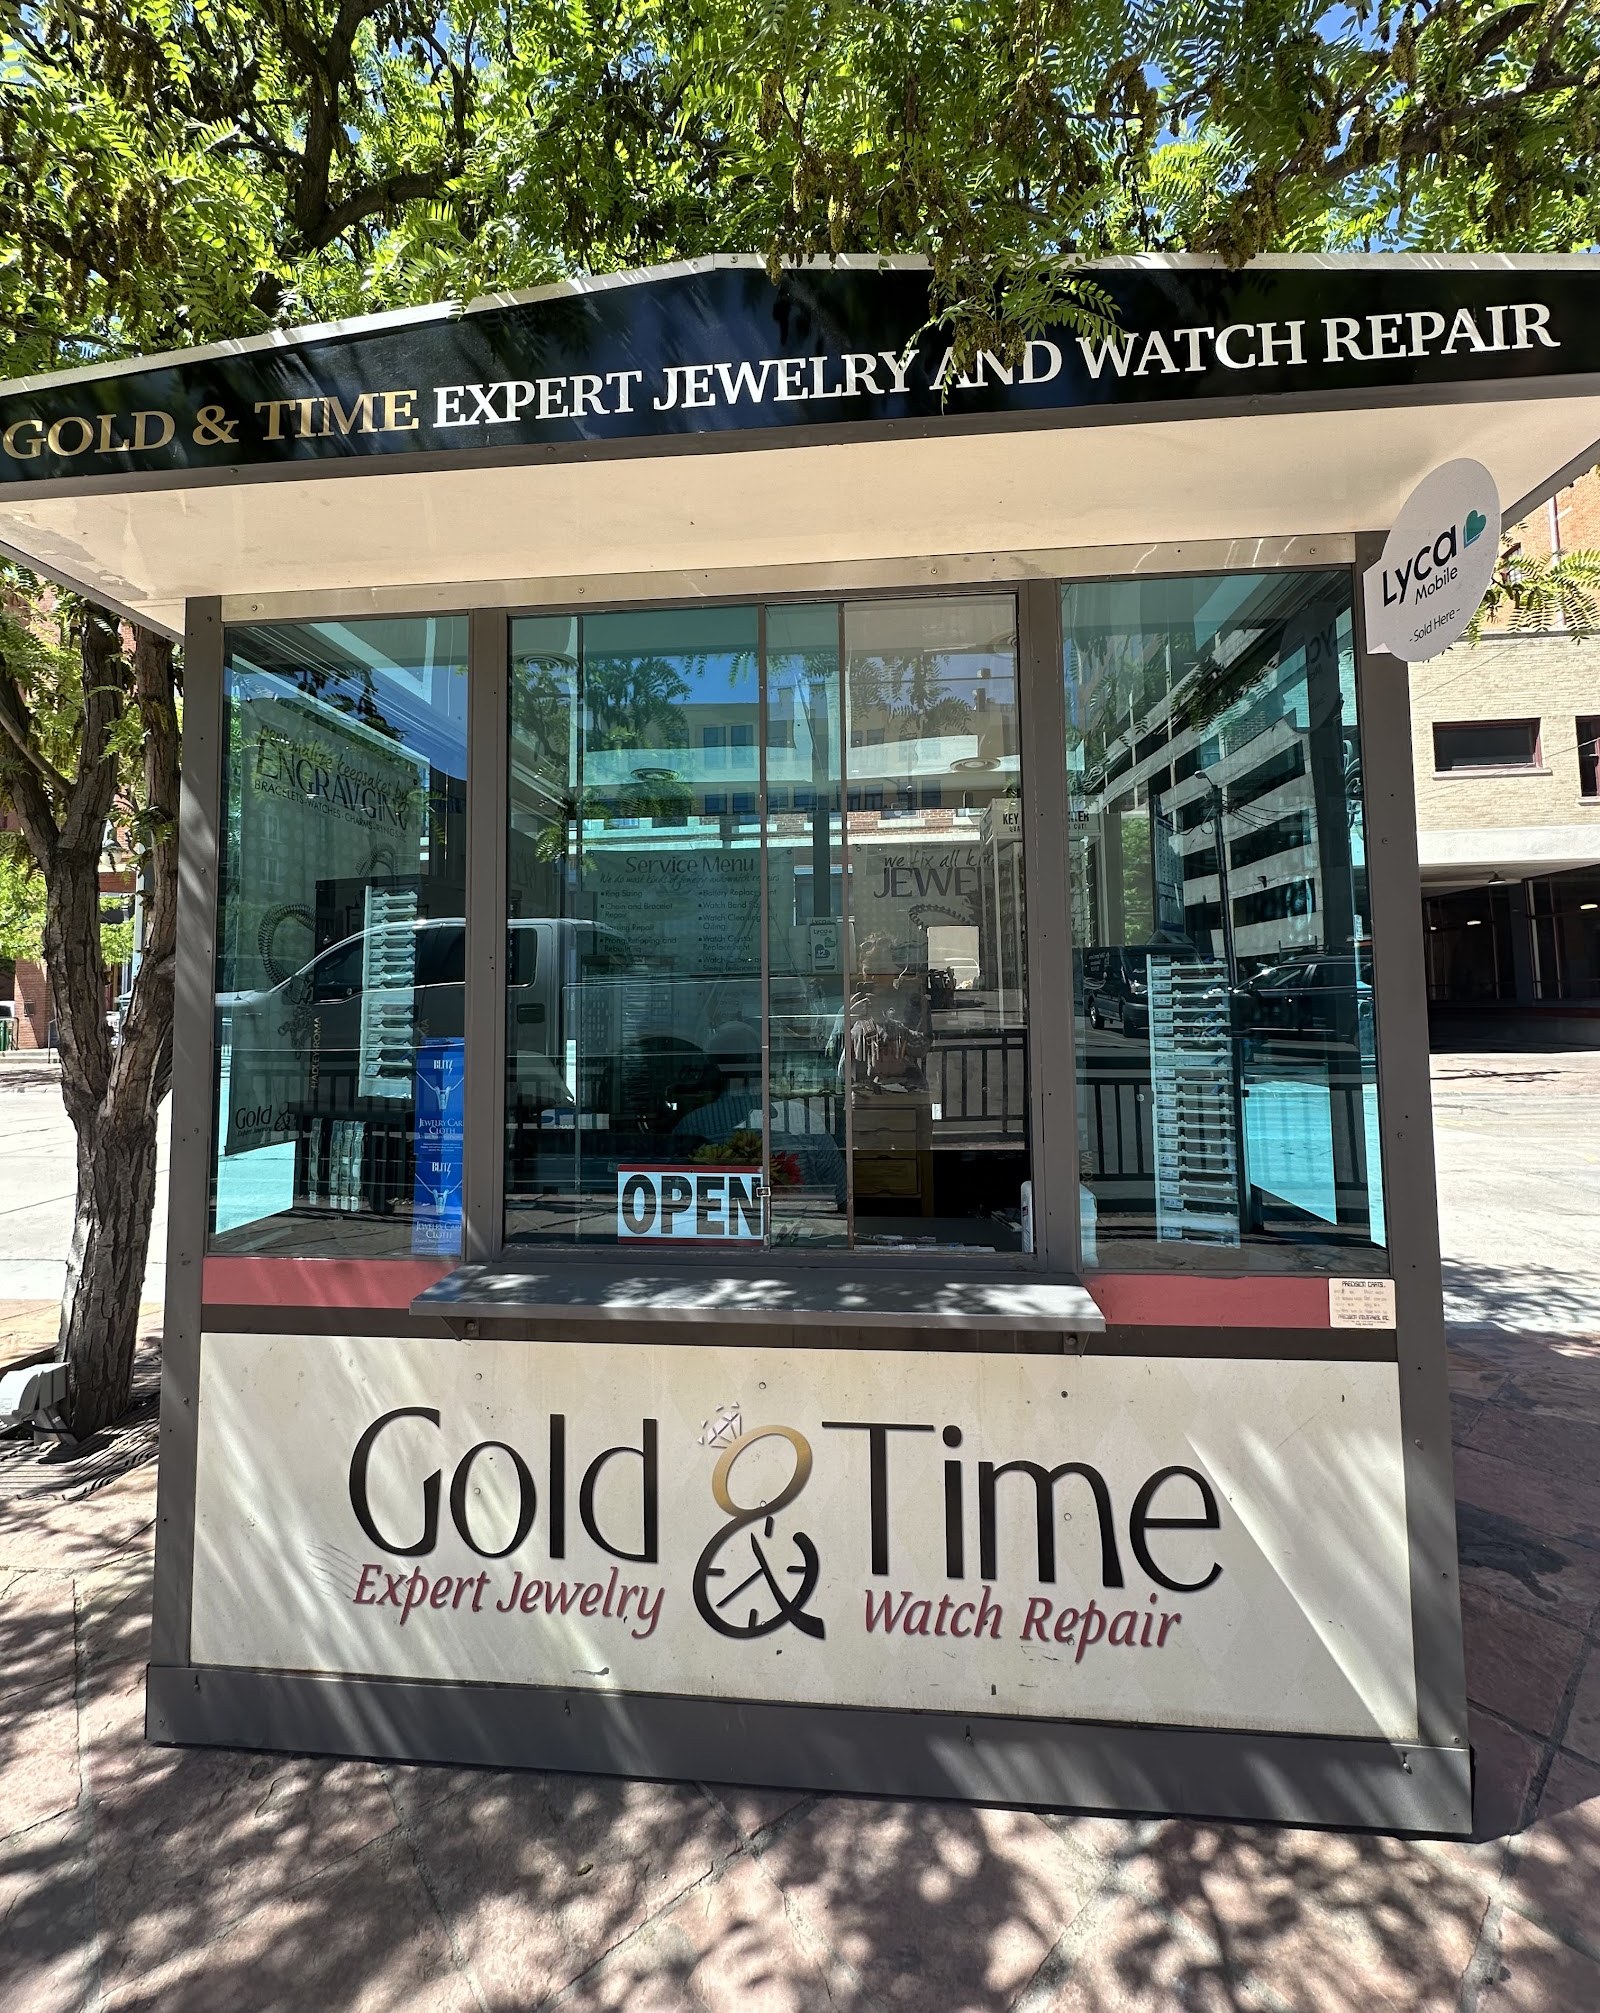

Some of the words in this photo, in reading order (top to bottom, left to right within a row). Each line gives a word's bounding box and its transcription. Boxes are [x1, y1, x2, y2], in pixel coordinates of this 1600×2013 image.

[2, 409, 175, 460] GOLD
[192, 405, 240, 445] &
[254, 389, 420, 441] TIME
[432, 371, 643, 429] EXPERT
[653, 350, 916, 412] JEWELRY
[930, 339, 1063, 391] AND
[1076, 320, 1305, 379] WATCH
[1321, 302, 1561, 363] REPAIR
[1382, 524, 1458, 608] Lyca
[1415, 566, 1459, 605] Mobile
[1414, 619, 1433, 643] Sold
[1433, 610, 1456, 631] Here
[1002, 813, 1019, 824] KEY
[625, 856, 698, 873] Service
[702, 855, 754, 873] Menu
[884, 855, 906, 868] we
[940, 849, 960, 868] all
[965, 849, 996, 867] kin
[235, 1104, 272, 1130] Gold
[622, 1174, 762, 1236] OPEN
[349, 1406, 658, 1564] Gold
[821, 1420, 1223, 1593] Time
[353, 1563, 491, 1627] Expert
[496, 1566, 666, 1640] Jewelry
[864, 1585, 1002, 1640] Watch
[1019, 1592, 1182, 1665] Repair
